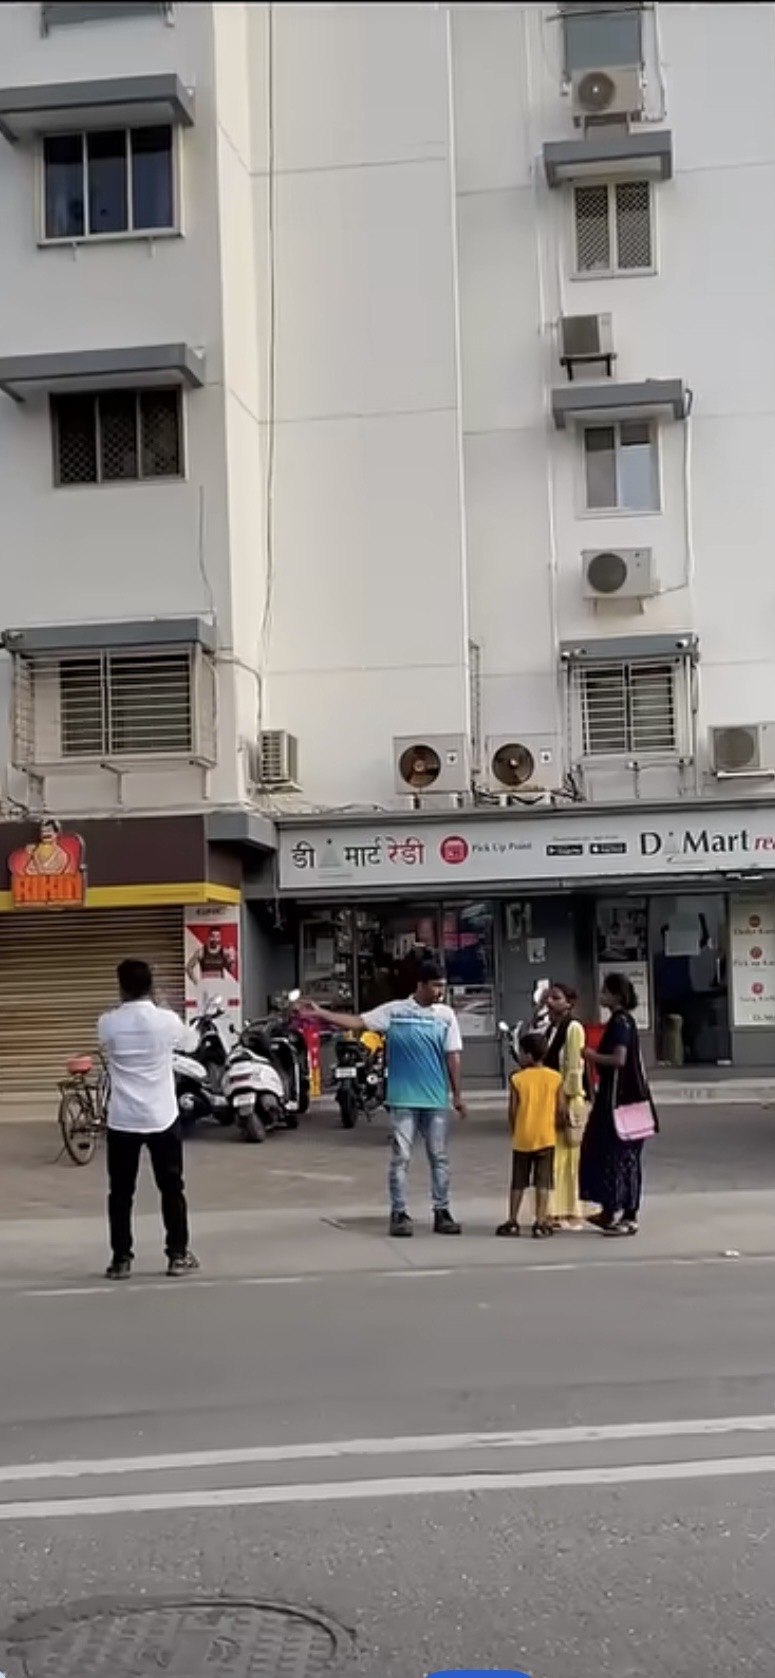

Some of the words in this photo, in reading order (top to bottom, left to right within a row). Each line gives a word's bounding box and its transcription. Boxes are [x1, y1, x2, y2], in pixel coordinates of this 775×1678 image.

[291, 841, 315, 869] डी
[344, 836, 382, 867] मार्ट
[385, 835, 425, 865] रेडी
[471, 844, 491, 853] Pick
[492, 843, 507, 855] Up
[508, 841, 532, 851] Point
[639, 831, 663, 856] D
[682, 829, 750, 854] Mart
